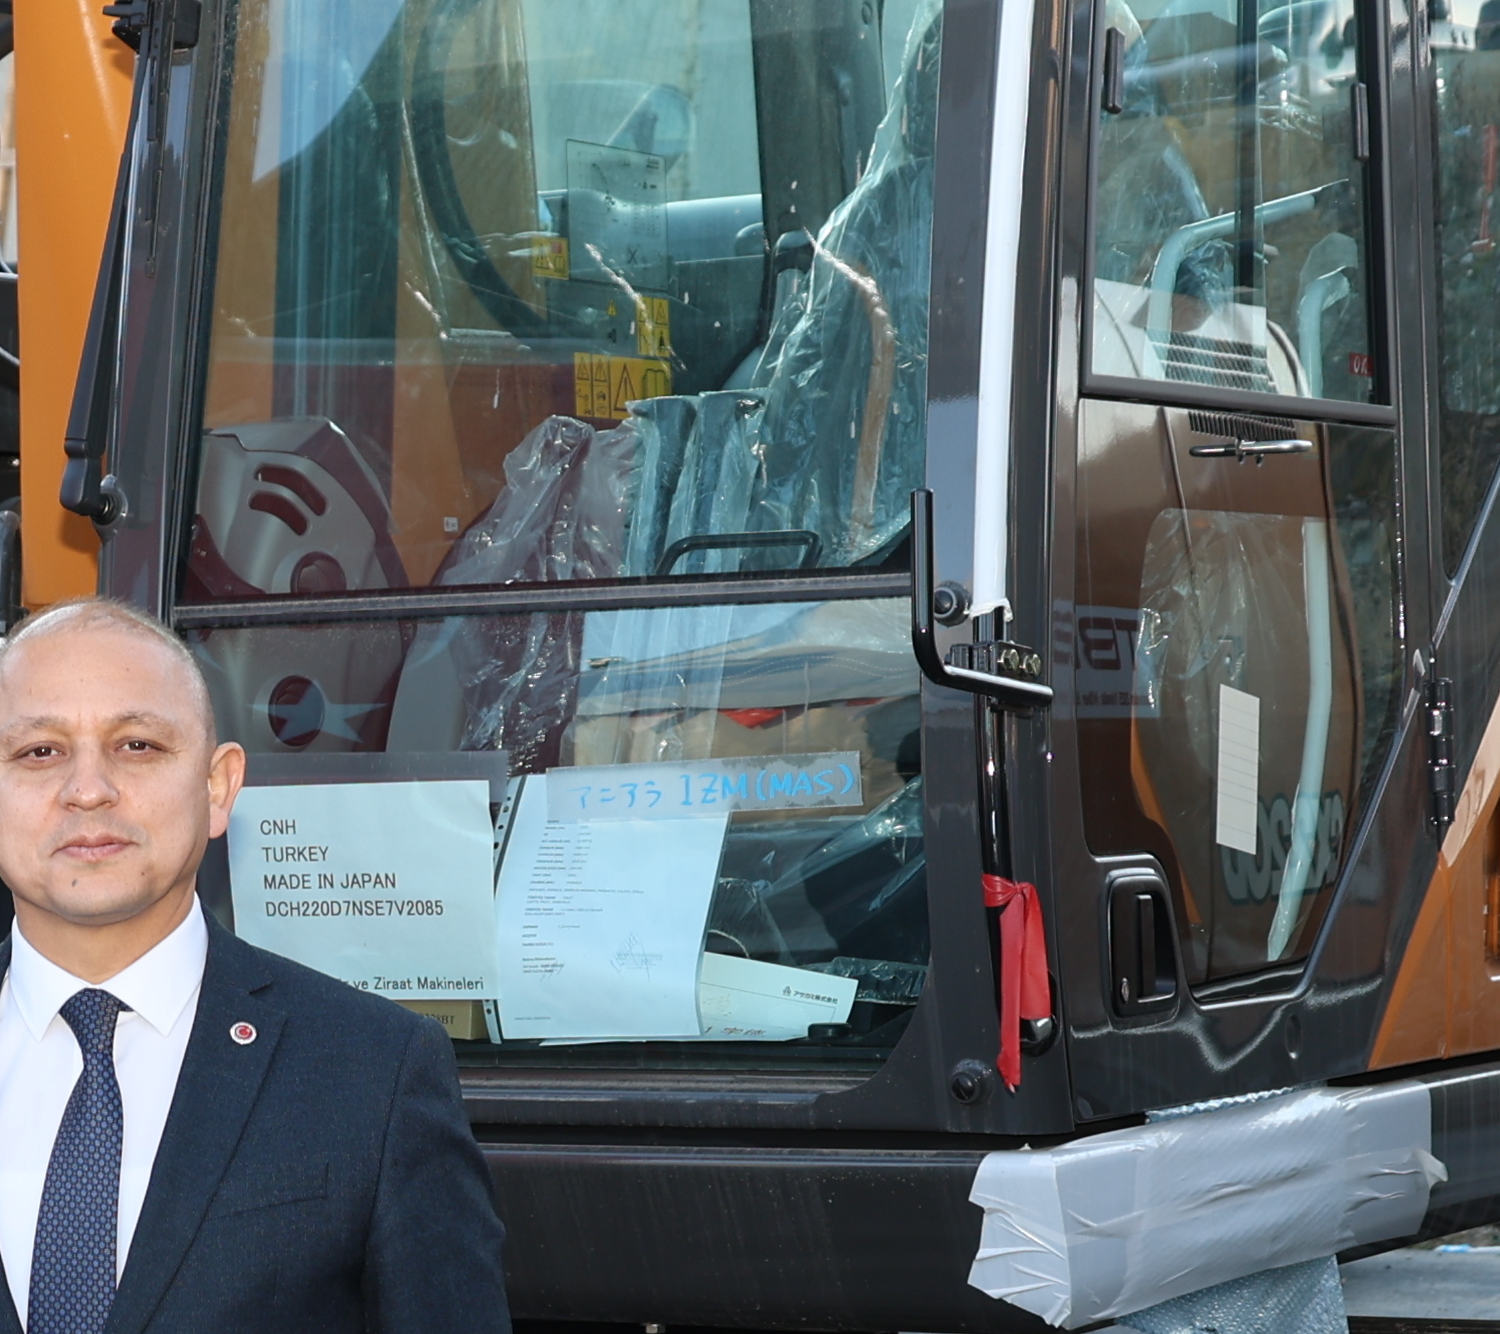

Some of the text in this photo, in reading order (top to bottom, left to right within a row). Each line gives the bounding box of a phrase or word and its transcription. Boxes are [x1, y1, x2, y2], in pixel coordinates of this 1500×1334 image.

[259, 819, 297, 836] CNH
[261, 846, 329, 863] TURKEY
[263, 872, 397, 890] MADE IN JAPAN
[265, 899, 444, 917] DCH220D7NSE7V2085
[353, 979, 369, 990] ve
[373, 976, 412, 990] Ziraat
[417, 976, 484, 990] Makineleri
